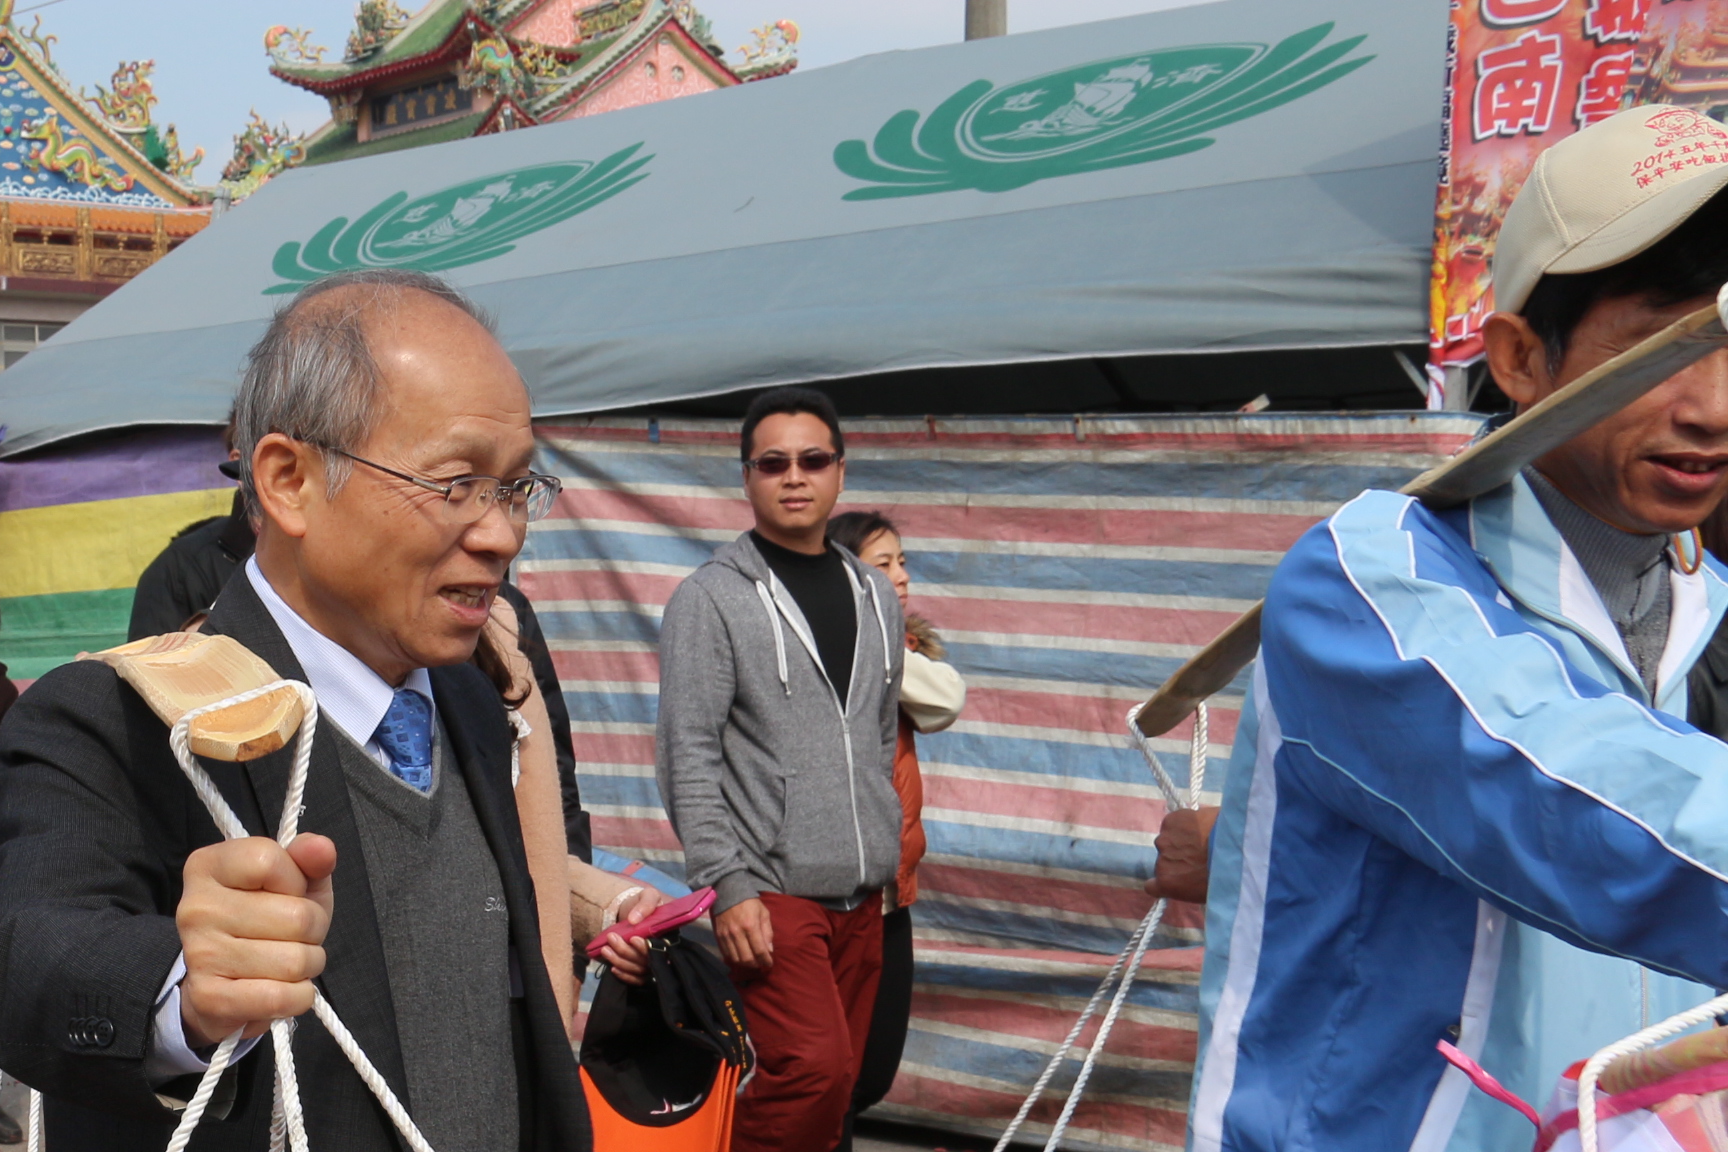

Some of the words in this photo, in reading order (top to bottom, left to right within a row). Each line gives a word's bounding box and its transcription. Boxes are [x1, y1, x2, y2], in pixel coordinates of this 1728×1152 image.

[1631, 150, 1676, 176] 2014
[1679, 141, 1728, 155] 五年千
